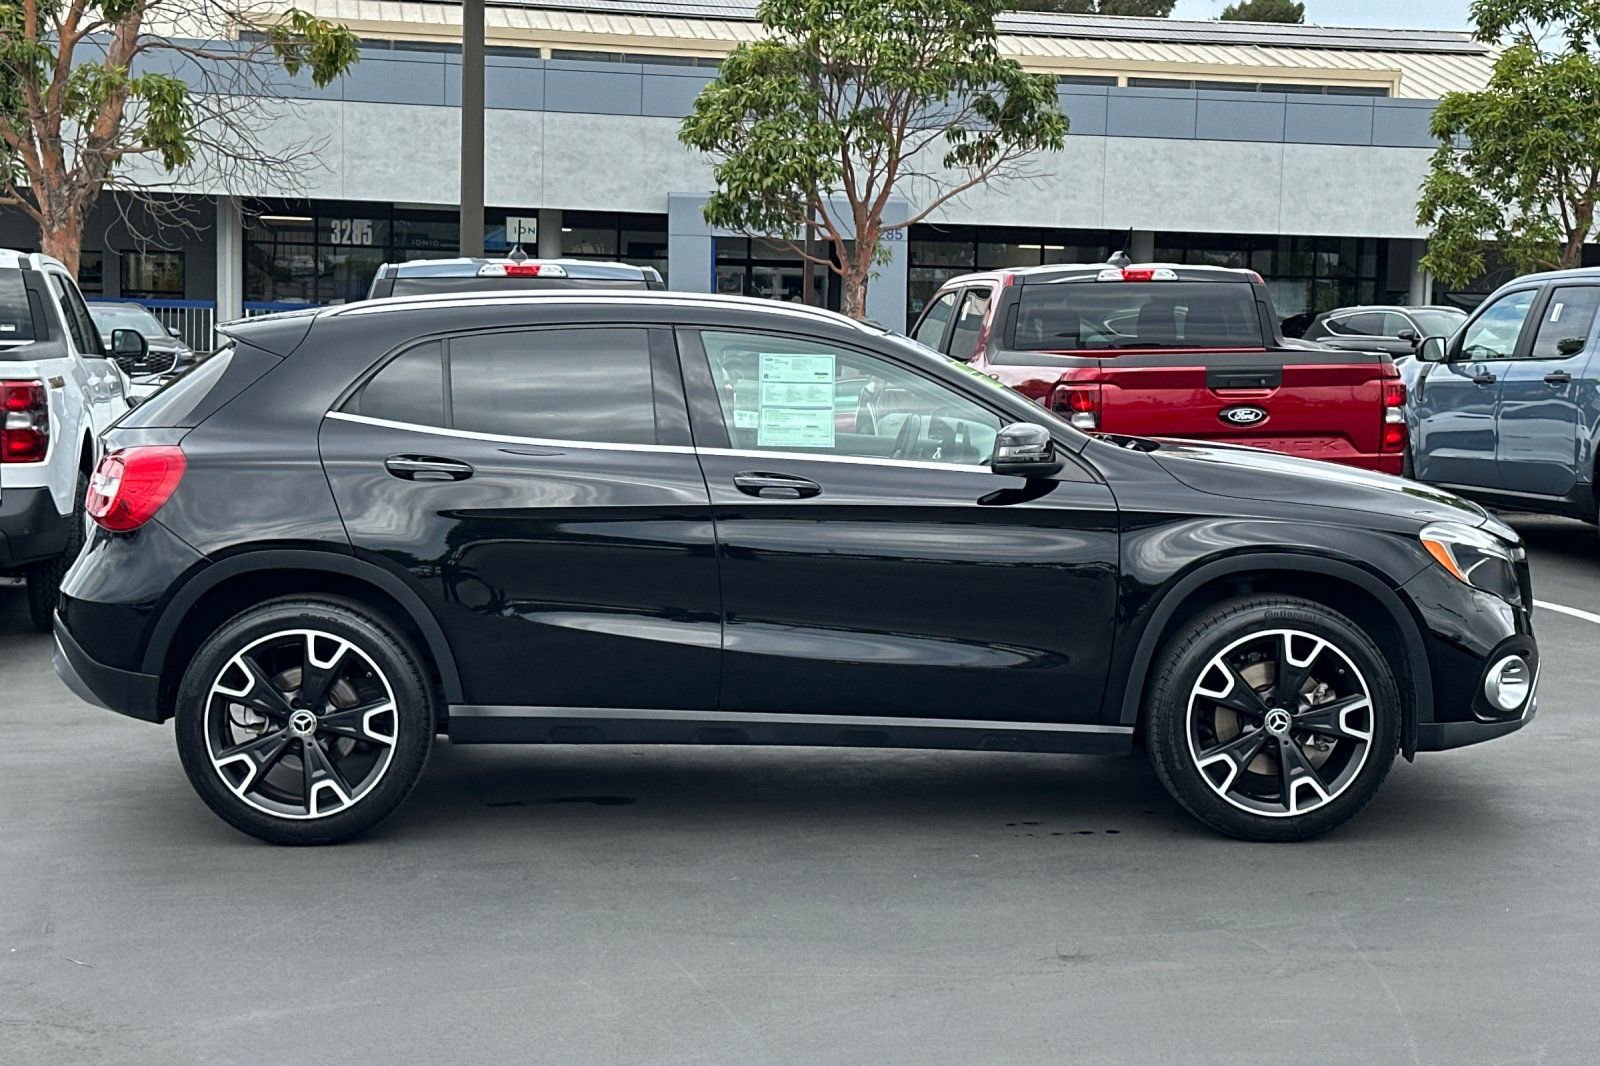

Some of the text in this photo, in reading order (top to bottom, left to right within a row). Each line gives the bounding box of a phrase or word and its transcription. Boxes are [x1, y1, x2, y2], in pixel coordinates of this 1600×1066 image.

[331, 219, 373, 245] 3285
[1234, 409, 1257, 420] Ford
[1234, 441, 1338, 451] RICK
